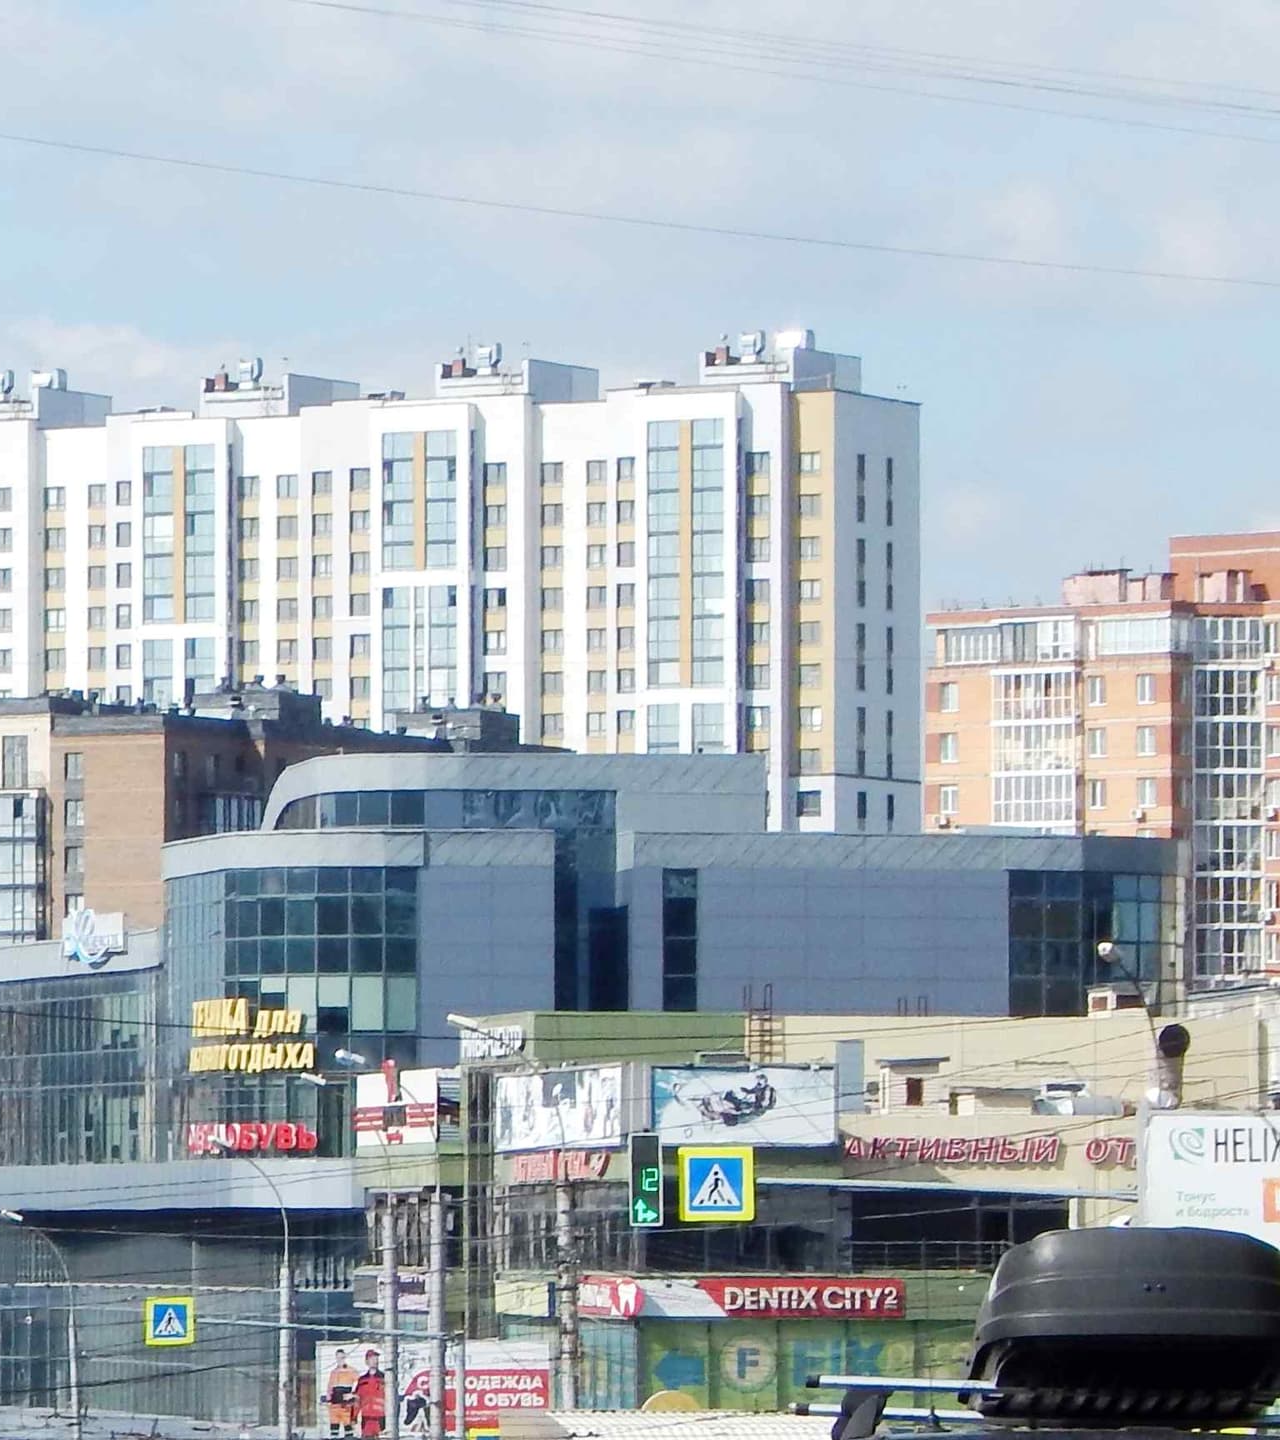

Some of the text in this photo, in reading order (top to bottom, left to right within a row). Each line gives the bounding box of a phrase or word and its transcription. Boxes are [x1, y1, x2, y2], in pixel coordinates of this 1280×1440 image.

[253, 1010, 302, 1038] ДЛЯ
[228, 1043, 314, 1073] ОТДЫХА
[843, 1136, 1137, 1166] АКТИВНЫЙ ОТ
[642, 1168, 658, 1191] 12
[1176, 1190, 1216, 1207] Тонус
[724, 1286, 819, 1310] DENTIX
[416, 1375, 544, 1391] СЕОДЕЖДА
[484, 1393, 545, 1407] ОБУВЬ
